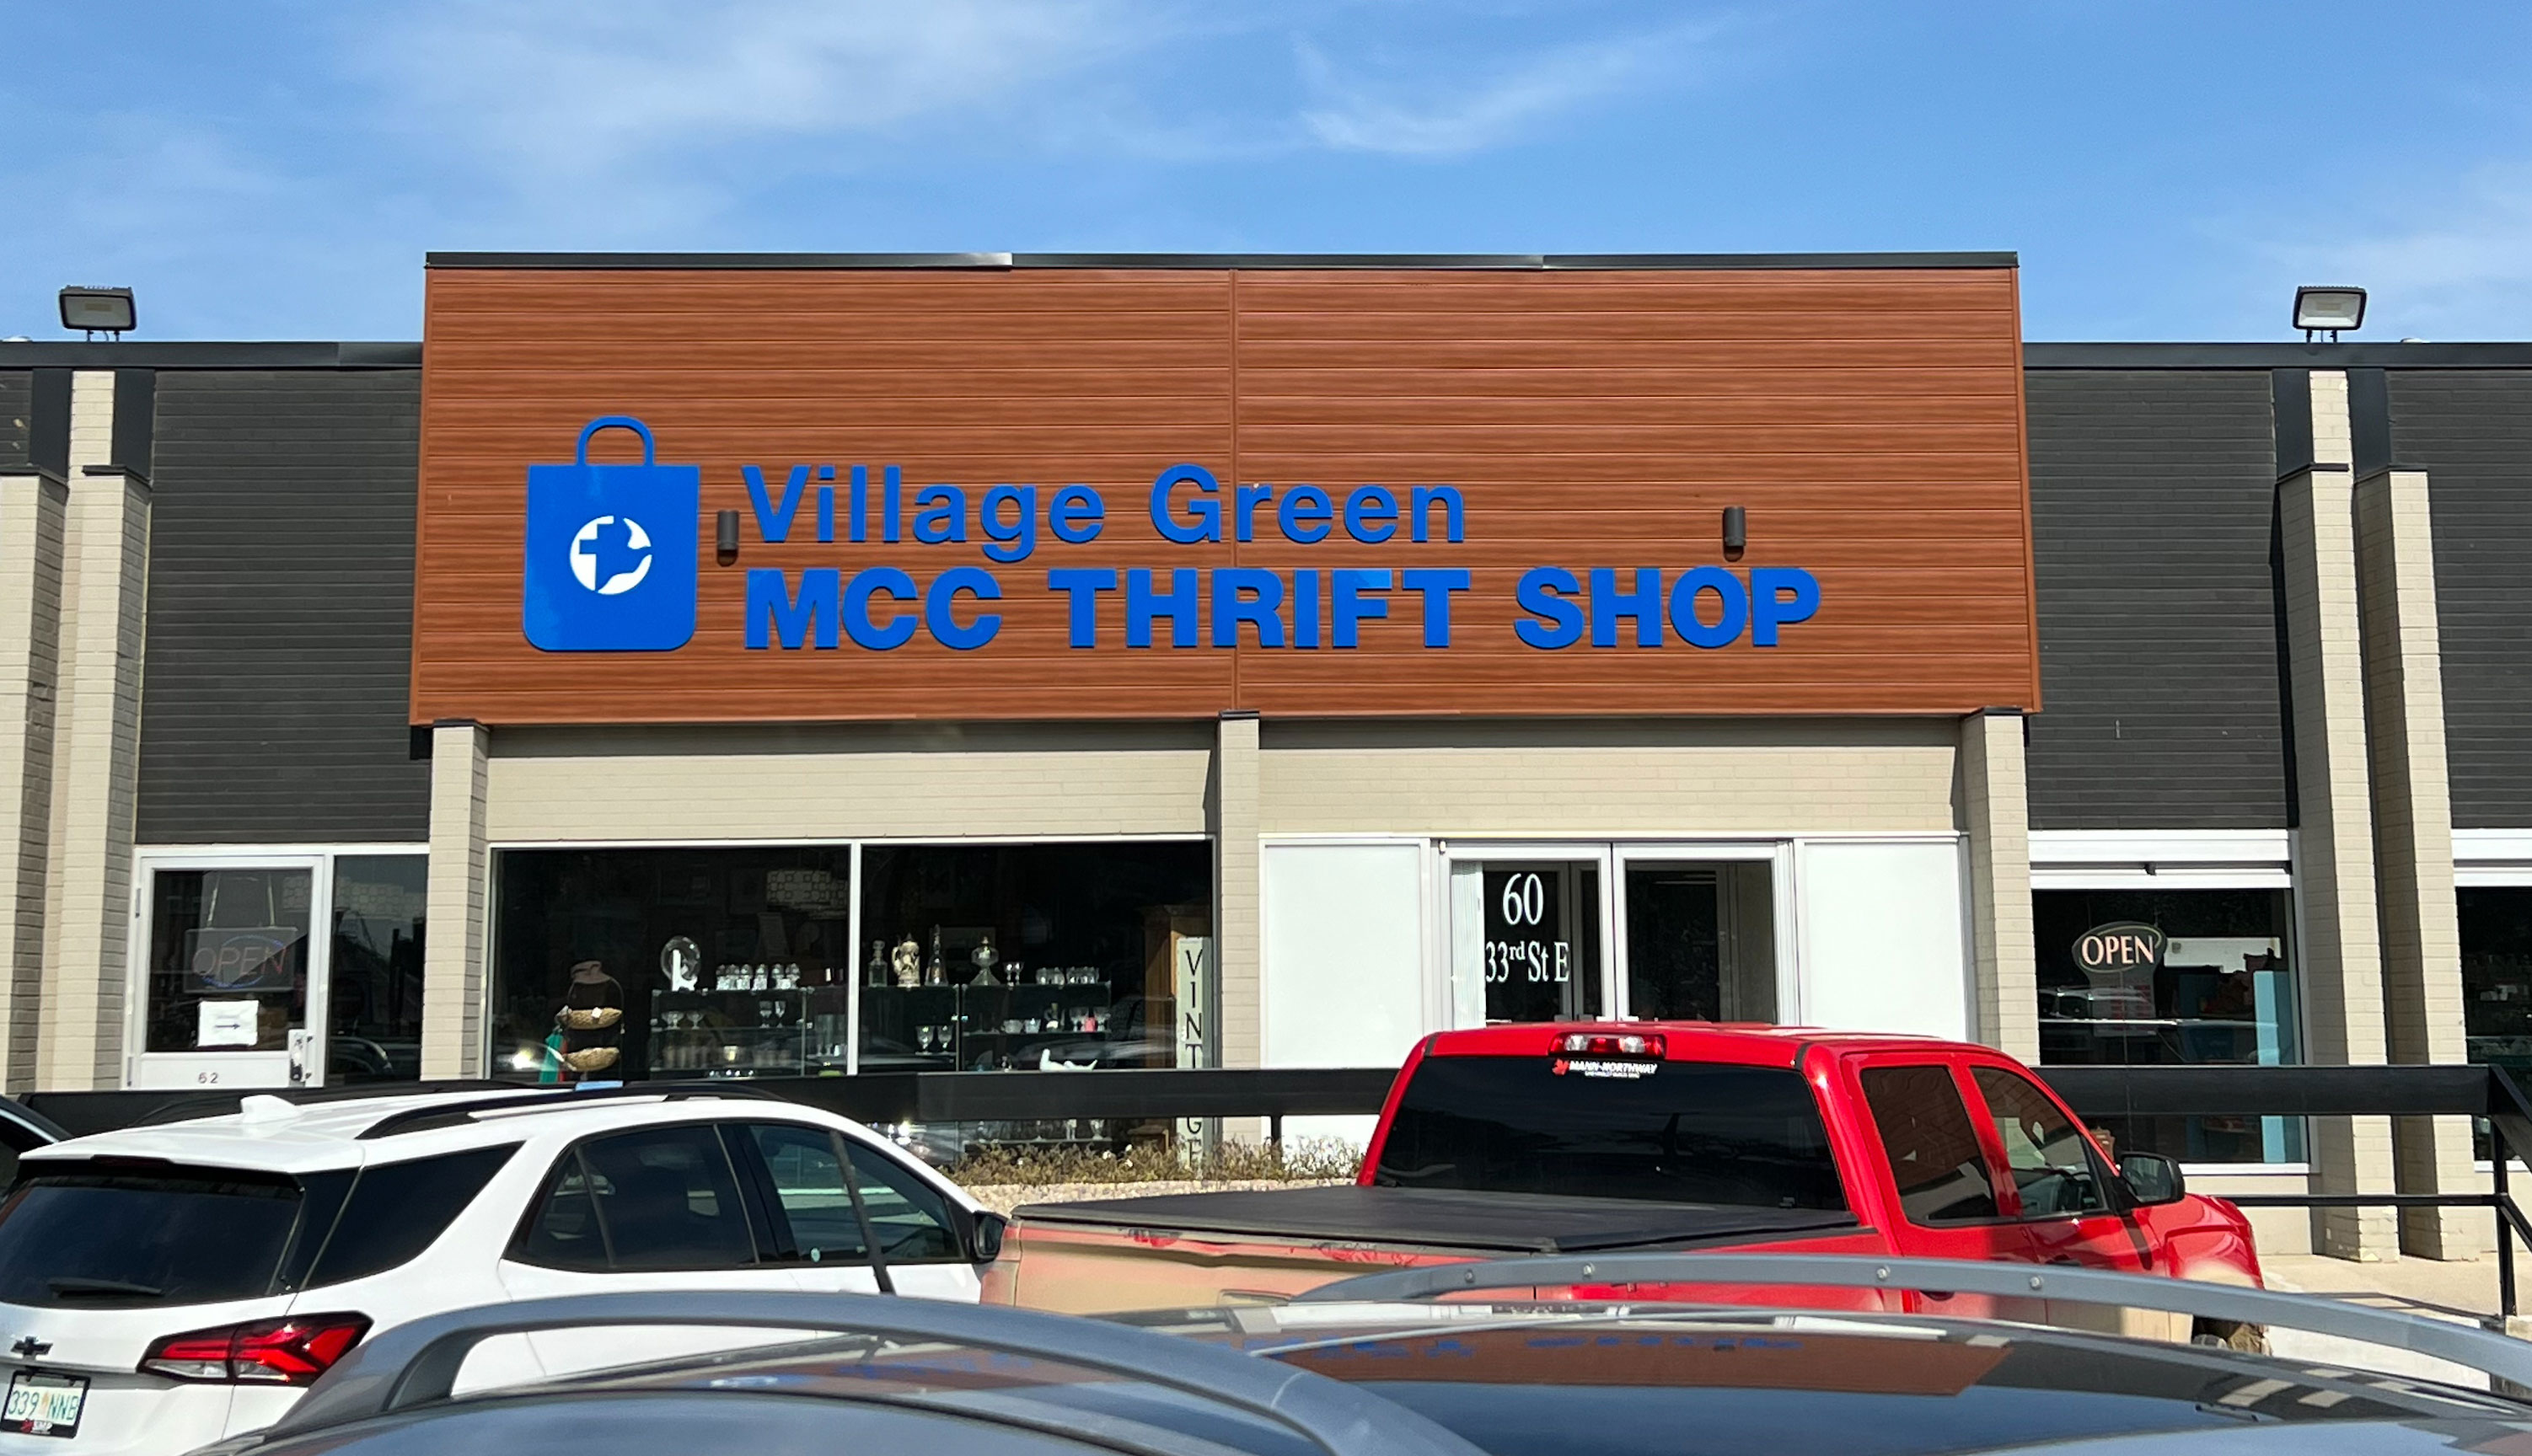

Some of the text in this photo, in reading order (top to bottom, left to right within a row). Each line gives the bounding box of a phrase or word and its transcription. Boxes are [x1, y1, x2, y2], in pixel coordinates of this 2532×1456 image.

[742, 463, 1463, 563] Village Green
[744, 566, 1821, 650] MCC THRIFT SHOP
[1502, 873, 1544, 925] 60
[192, 945, 288, 977] OPEN
[1485, 939, 1570, 982] 33rd St E
[2081, 934, 2154, 966] OPEN
[198, 1072, 219, 1084] 62
[1184, 949, 1204, 1168] VINTGE
[8, 1389, 40, 1419] 339
